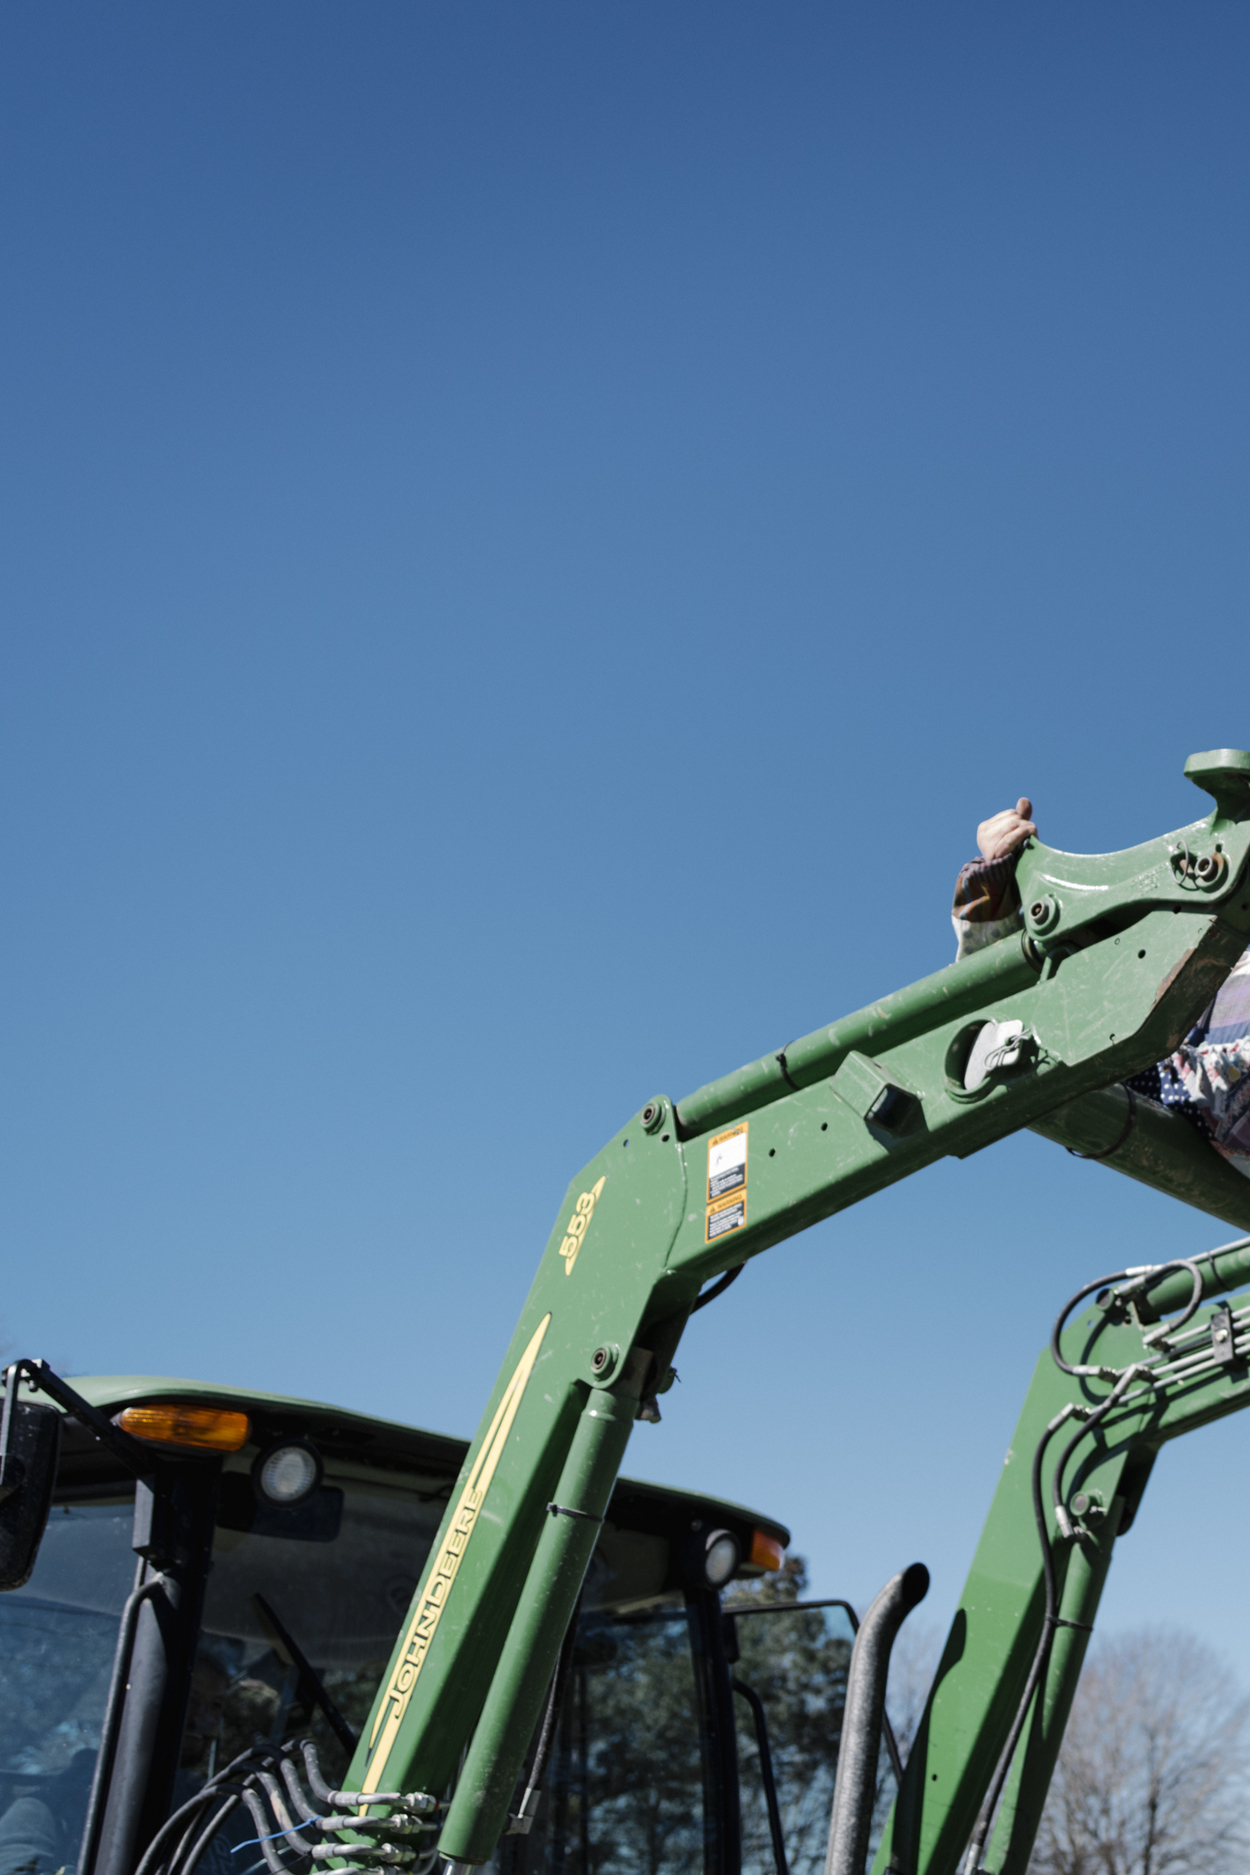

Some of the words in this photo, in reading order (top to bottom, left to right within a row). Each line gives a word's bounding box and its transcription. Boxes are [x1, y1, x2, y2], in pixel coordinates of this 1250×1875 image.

[558, 1192, 597, 1258] 553
[717, 1193, 743, 1209] WARNING
[389, 1608, 438, 1719] JOHN
[424, 1488, 482, 1608] DEERE
